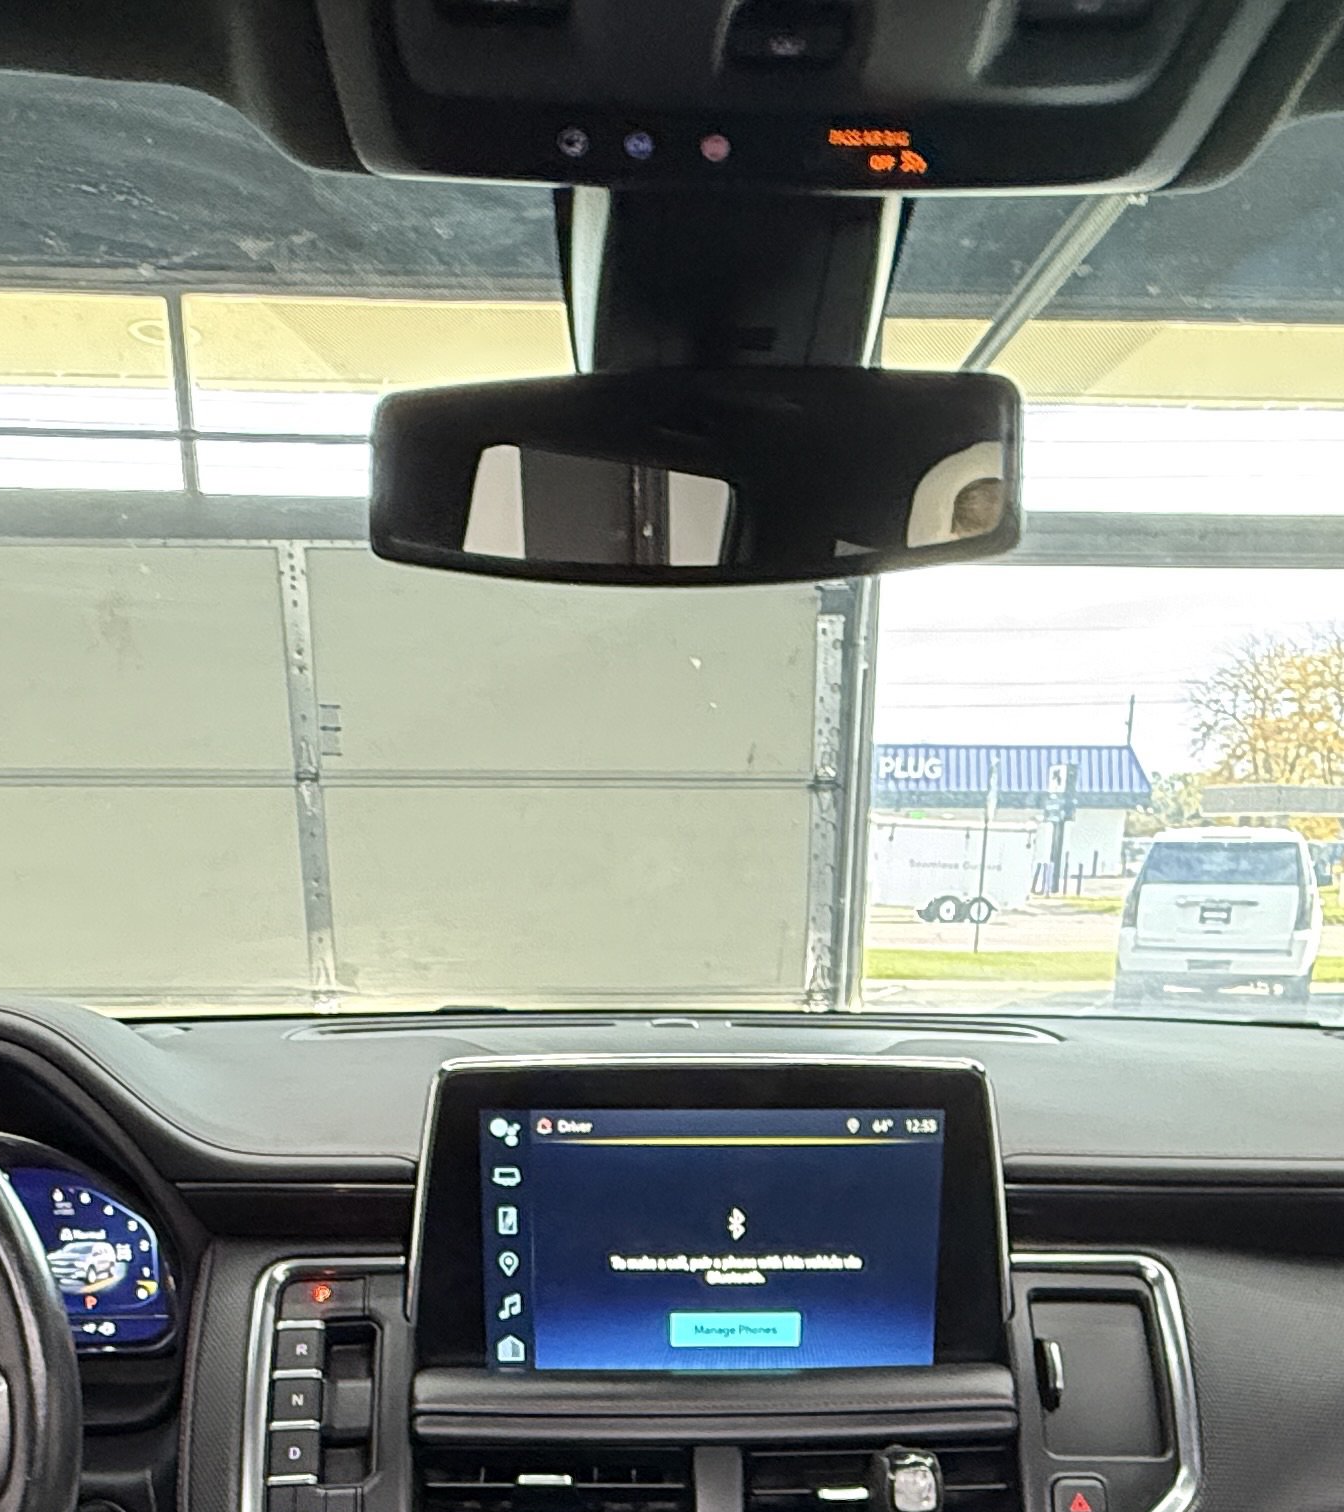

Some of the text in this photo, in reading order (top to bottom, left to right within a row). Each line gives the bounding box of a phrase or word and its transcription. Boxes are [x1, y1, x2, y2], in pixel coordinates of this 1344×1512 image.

[878, 756, 942, 779] PLUG
[557, 1119, 594, 1133] Driver
[757, 1255, 783, 1269] with
[84, 1295, 97, 1310] P
[694, 1325, 778, 1337] Manage Phones
[295, 1343, 308, 1356] R
[291, 1394, 304, 1406] N
[288, 1447, 302, 1460] D
